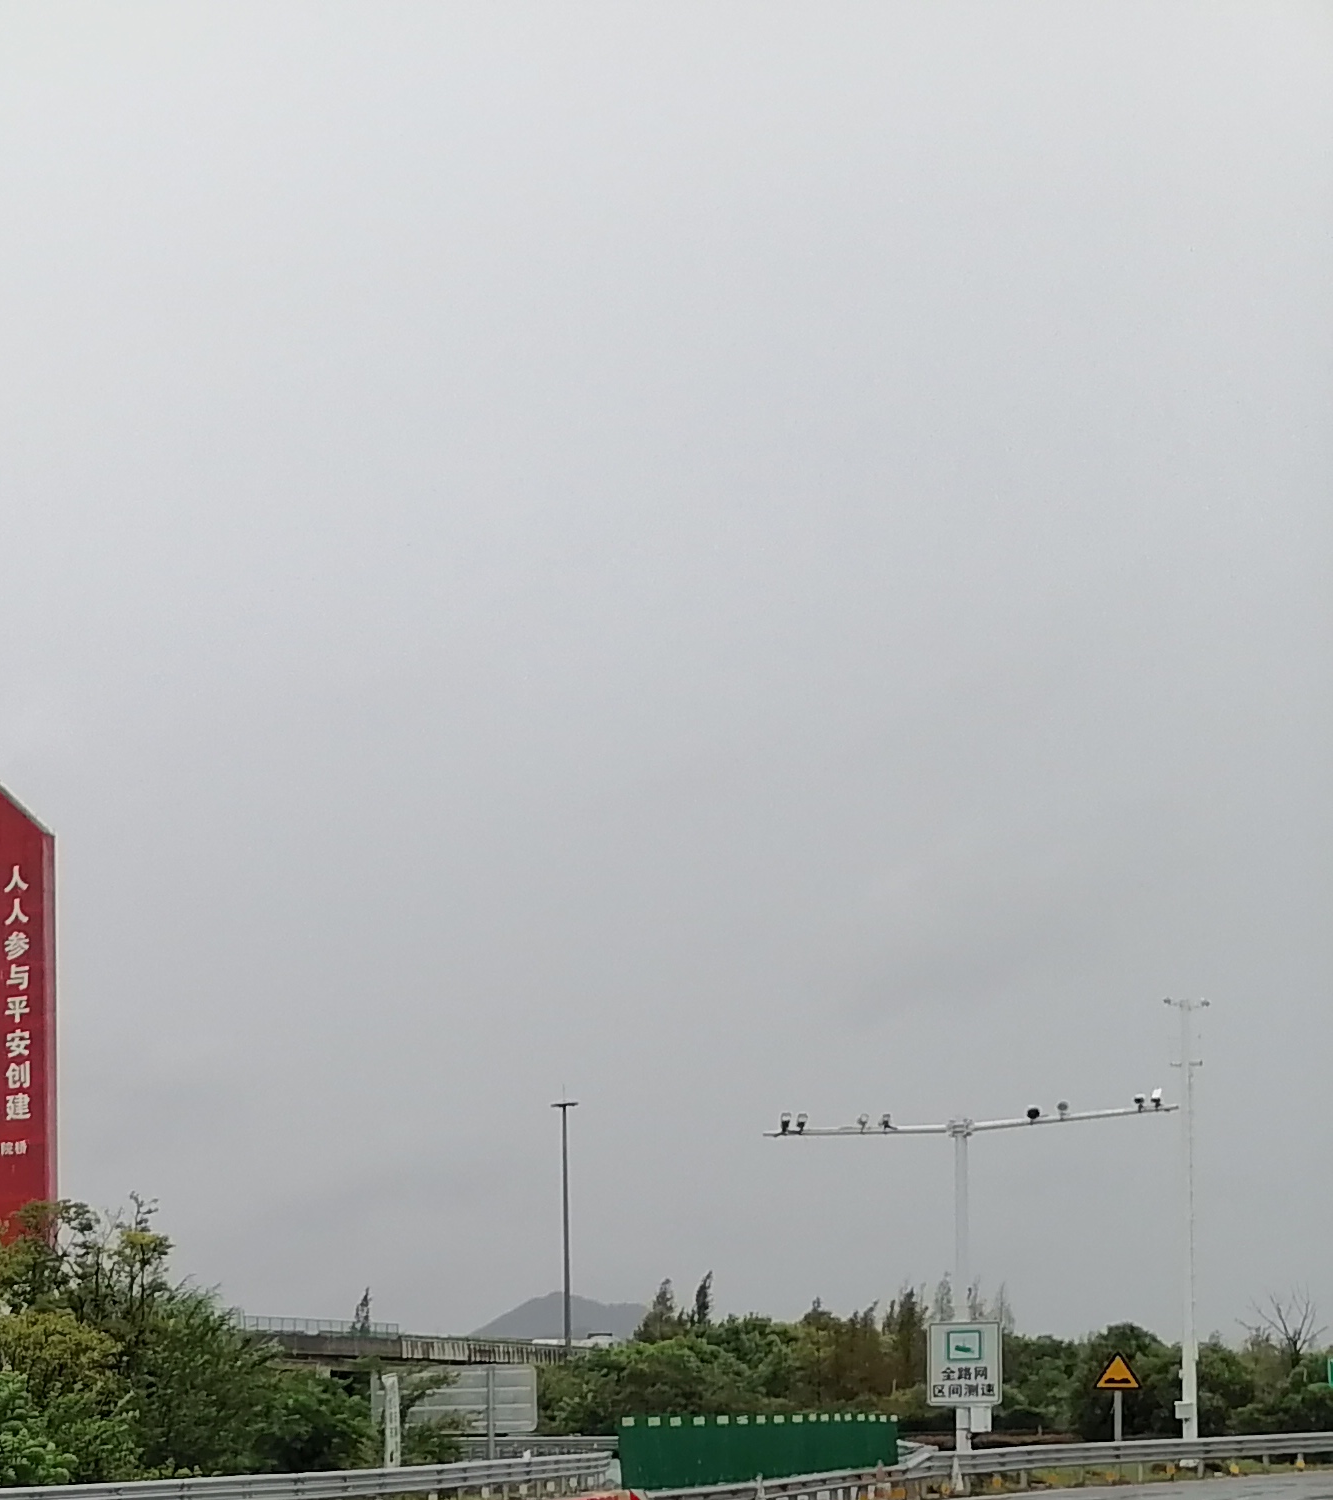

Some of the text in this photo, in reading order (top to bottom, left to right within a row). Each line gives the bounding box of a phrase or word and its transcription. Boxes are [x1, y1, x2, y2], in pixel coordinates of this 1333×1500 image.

[4, 865, 31, 1121] 人人参与平安创建
[941, 1366, 988, 1380] 全路网
[933, 1383, 995, 1398] 区间测速
